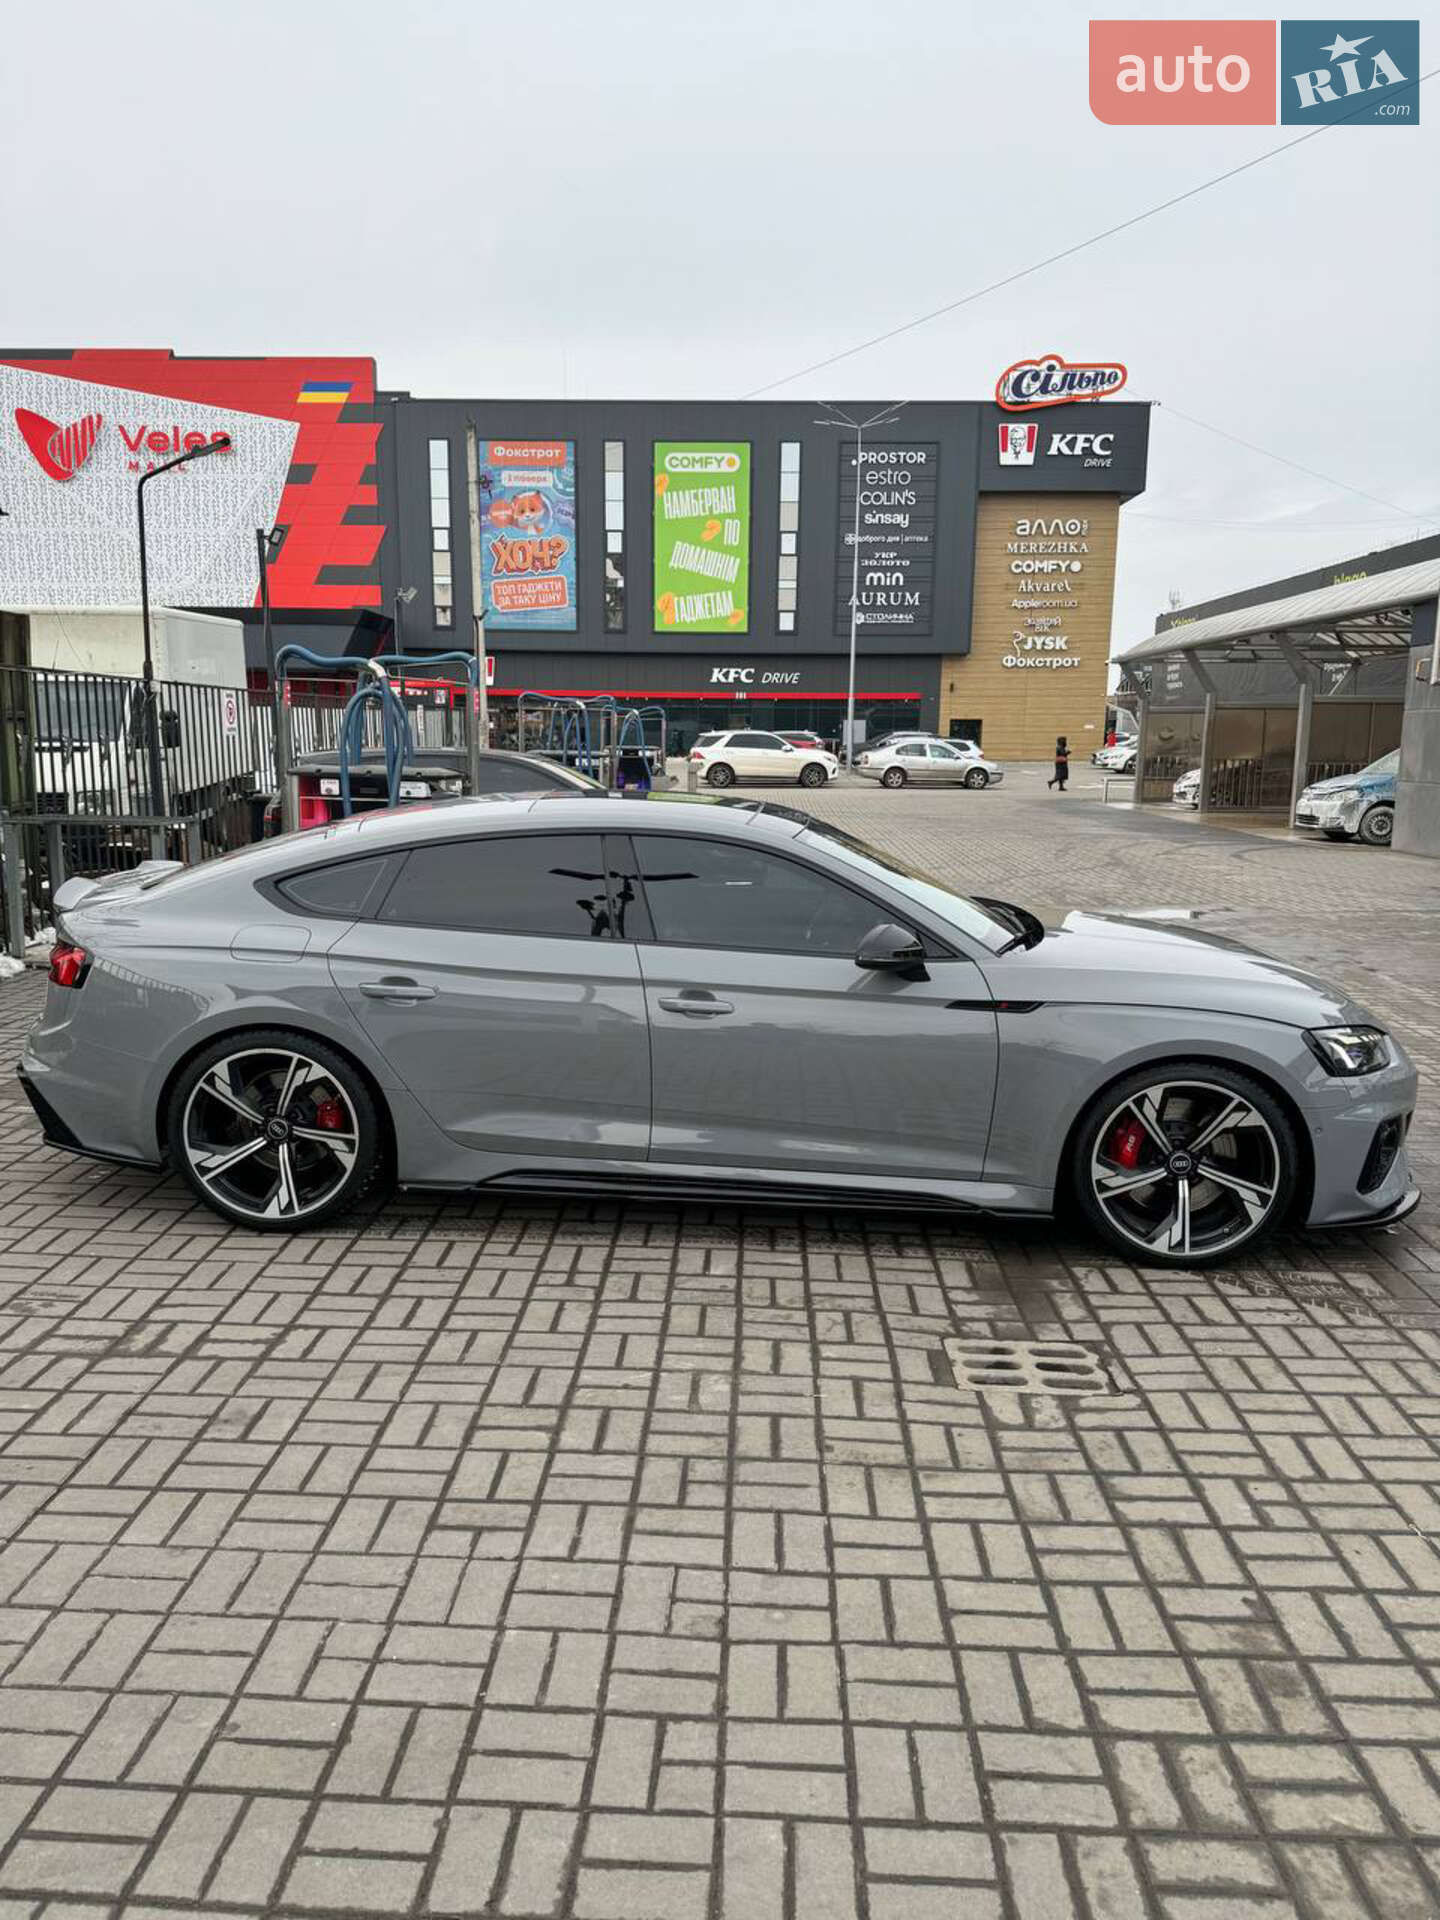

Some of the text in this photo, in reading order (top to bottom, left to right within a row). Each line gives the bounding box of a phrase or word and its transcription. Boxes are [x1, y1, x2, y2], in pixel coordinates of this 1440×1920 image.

[1011, 364, 1119, 399] Сільпо
[1046, 433, 1115, 456] KFC
[494, 446, 562, 459] Фокстрот
[859, 452, 926, 465] PROSTOR
[668, 456, 725, 469] COMFY
[1084, 458, 1113, 468] DRIVE
[865, 468, 912, 486] estro
[664, 485, 737, 521] НАМБЕРВАН
[860, 491, 917, 506] COLIN'S
[864, 510, 910, 529] sinsay
[724, 518, 741, 547] ПО
[1008, 542, 1089, 554] MEREZHKA
[669, 541, 741, 585] ДОМАШНІМ
[1011, 559, 1071, 574] COMFY
[866, 572, 904, 586] min
[1018, 578, 1072, 593] Akvarel
[848, 591, 921, 606] AURUM
[674, 589, 735, 625] ГАДЖЕТАМ
[1024, 636, 1069, 650] JYSK
[1003, 655, 1081, 669] Фокстрот
[709, 667, 801, 685] KFC DRIVE
